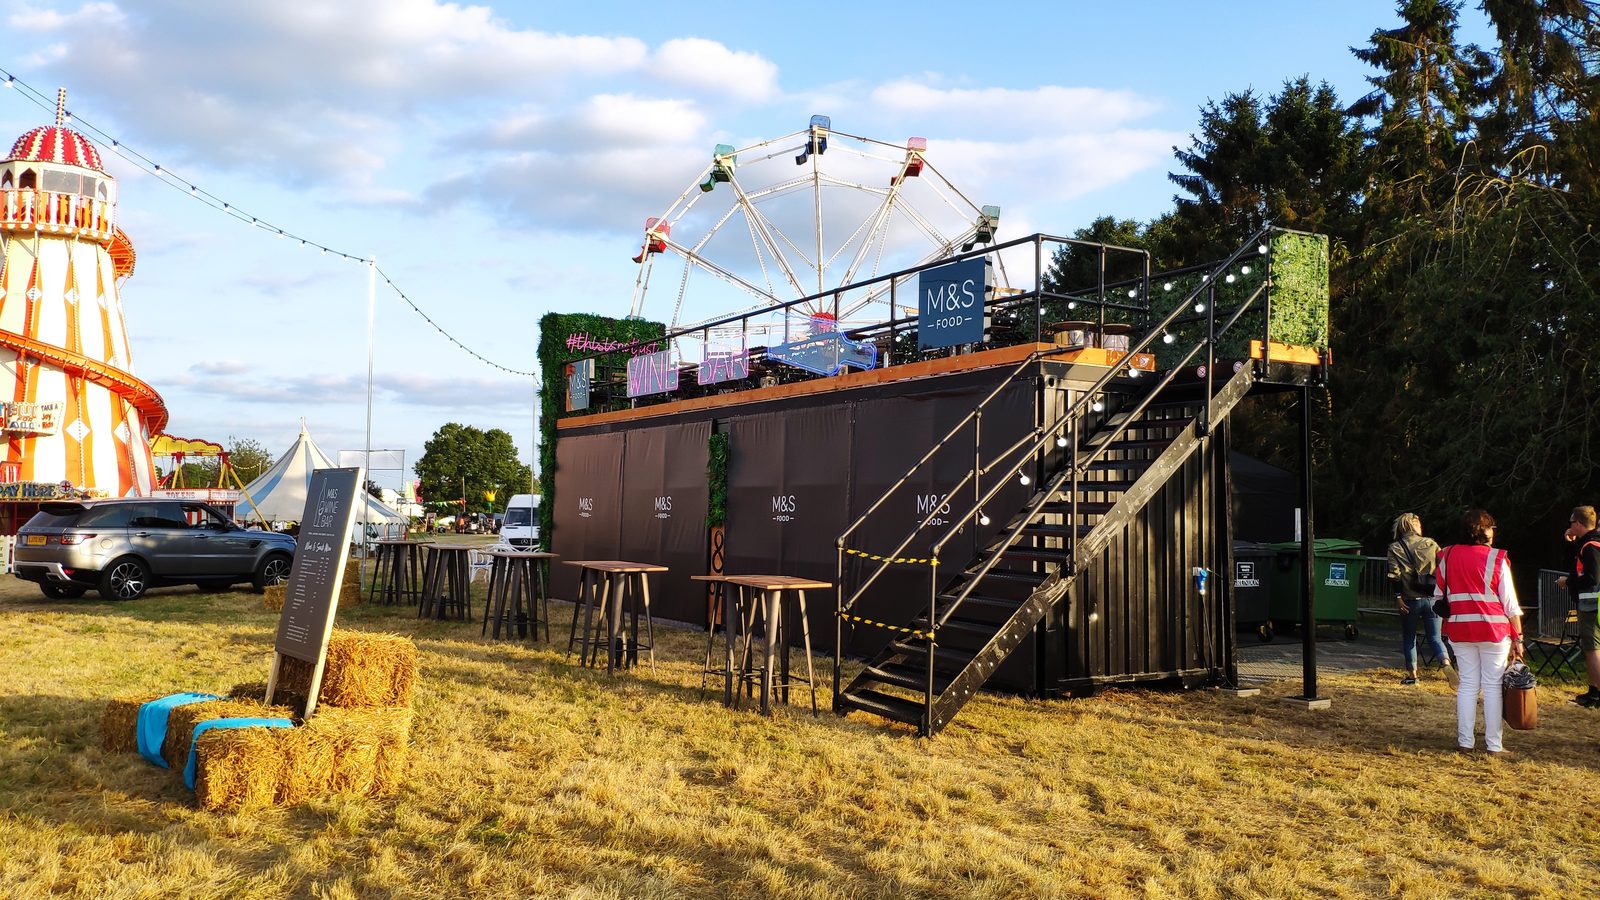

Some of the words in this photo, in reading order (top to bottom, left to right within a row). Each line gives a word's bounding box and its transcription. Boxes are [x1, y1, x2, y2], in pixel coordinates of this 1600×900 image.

[927, 279, 975, 315] M&S
[936, 316, 963, 329] FOOD
[627, 350, 678, 395] WINE
[698, 334, 748, 384] BAR
[579, 498, 593, 511] M&S
[655, 496, 672, 511] M&S
[772, 495, 796, 512] M&S
[917, 494, 951, 514] M&S
